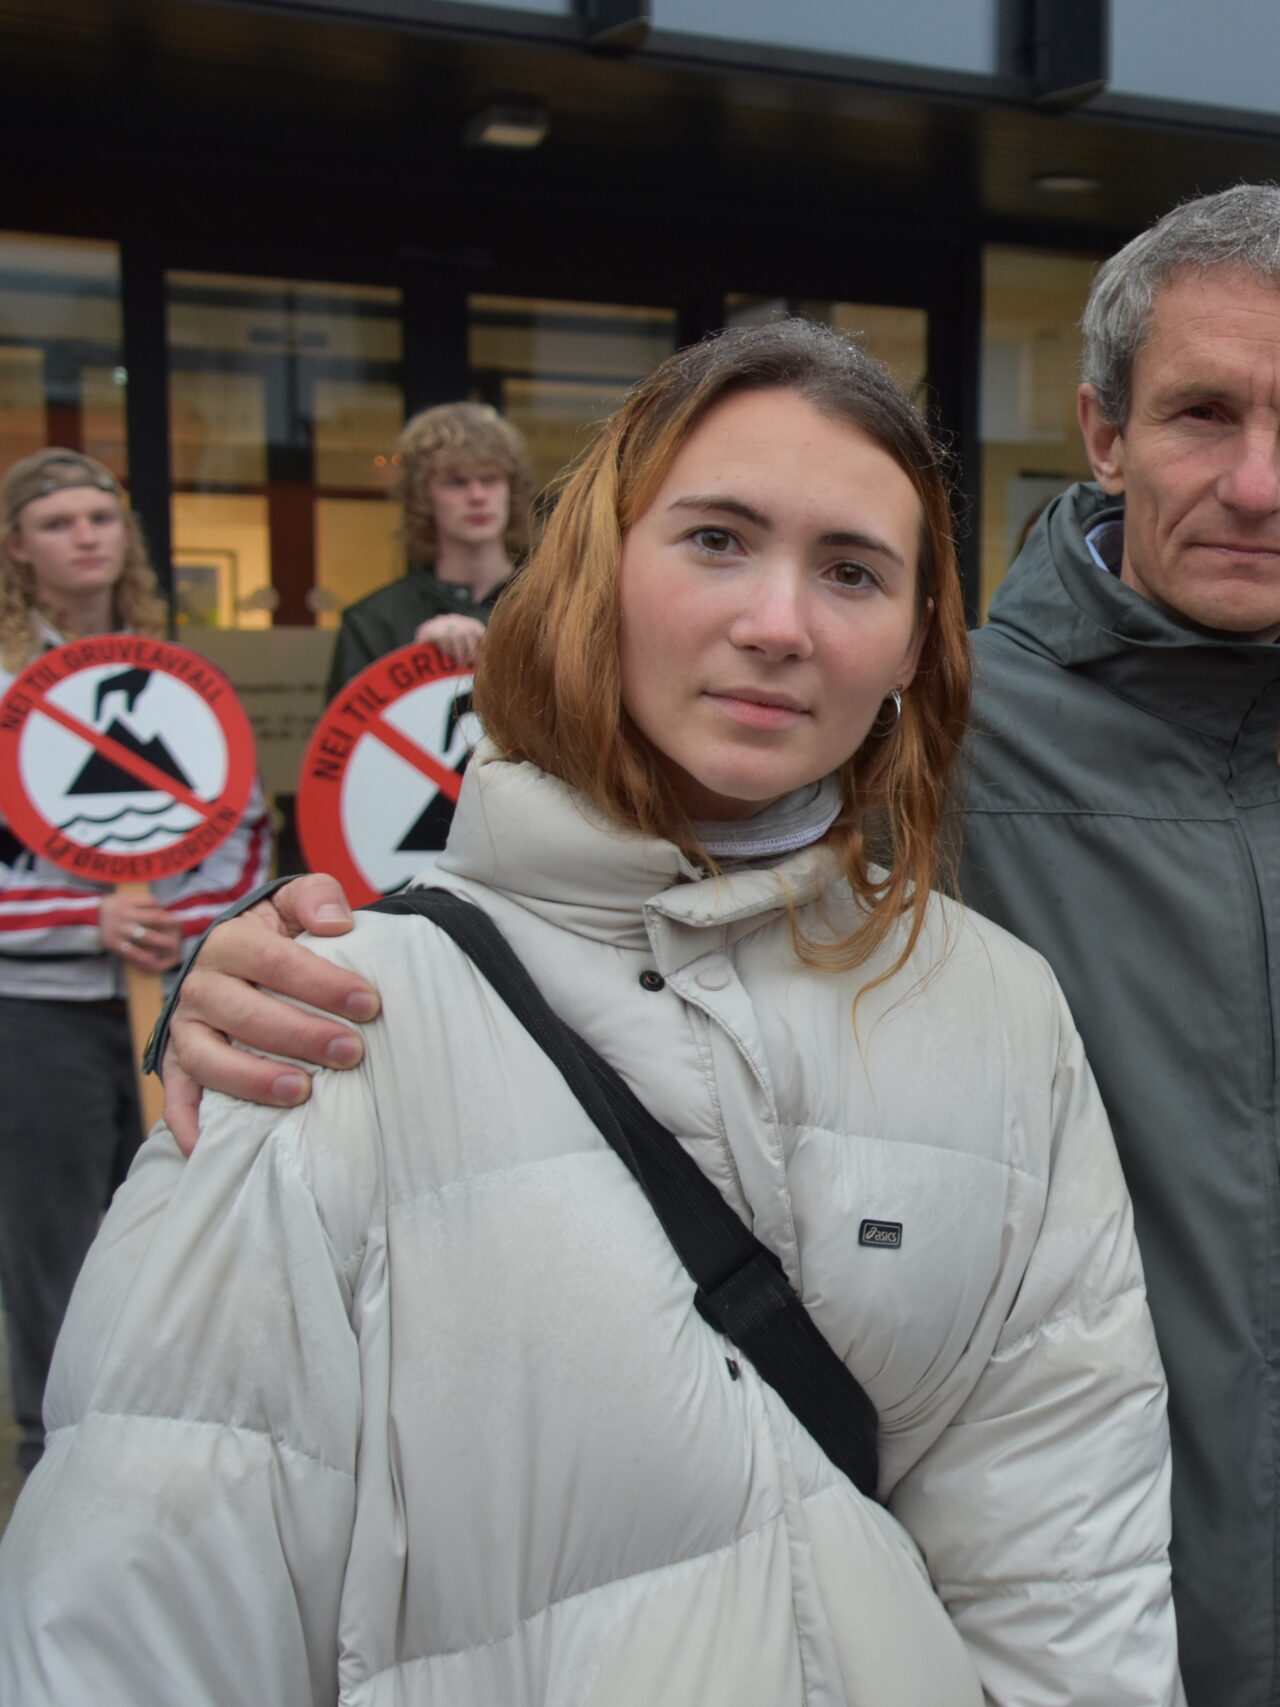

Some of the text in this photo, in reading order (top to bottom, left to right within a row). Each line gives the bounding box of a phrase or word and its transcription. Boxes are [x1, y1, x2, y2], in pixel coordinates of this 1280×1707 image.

[1, 641, 224, 731] NEI TIL GRUVEAVFALL
[313, 648, 473, 781] NEI TIL GRU
